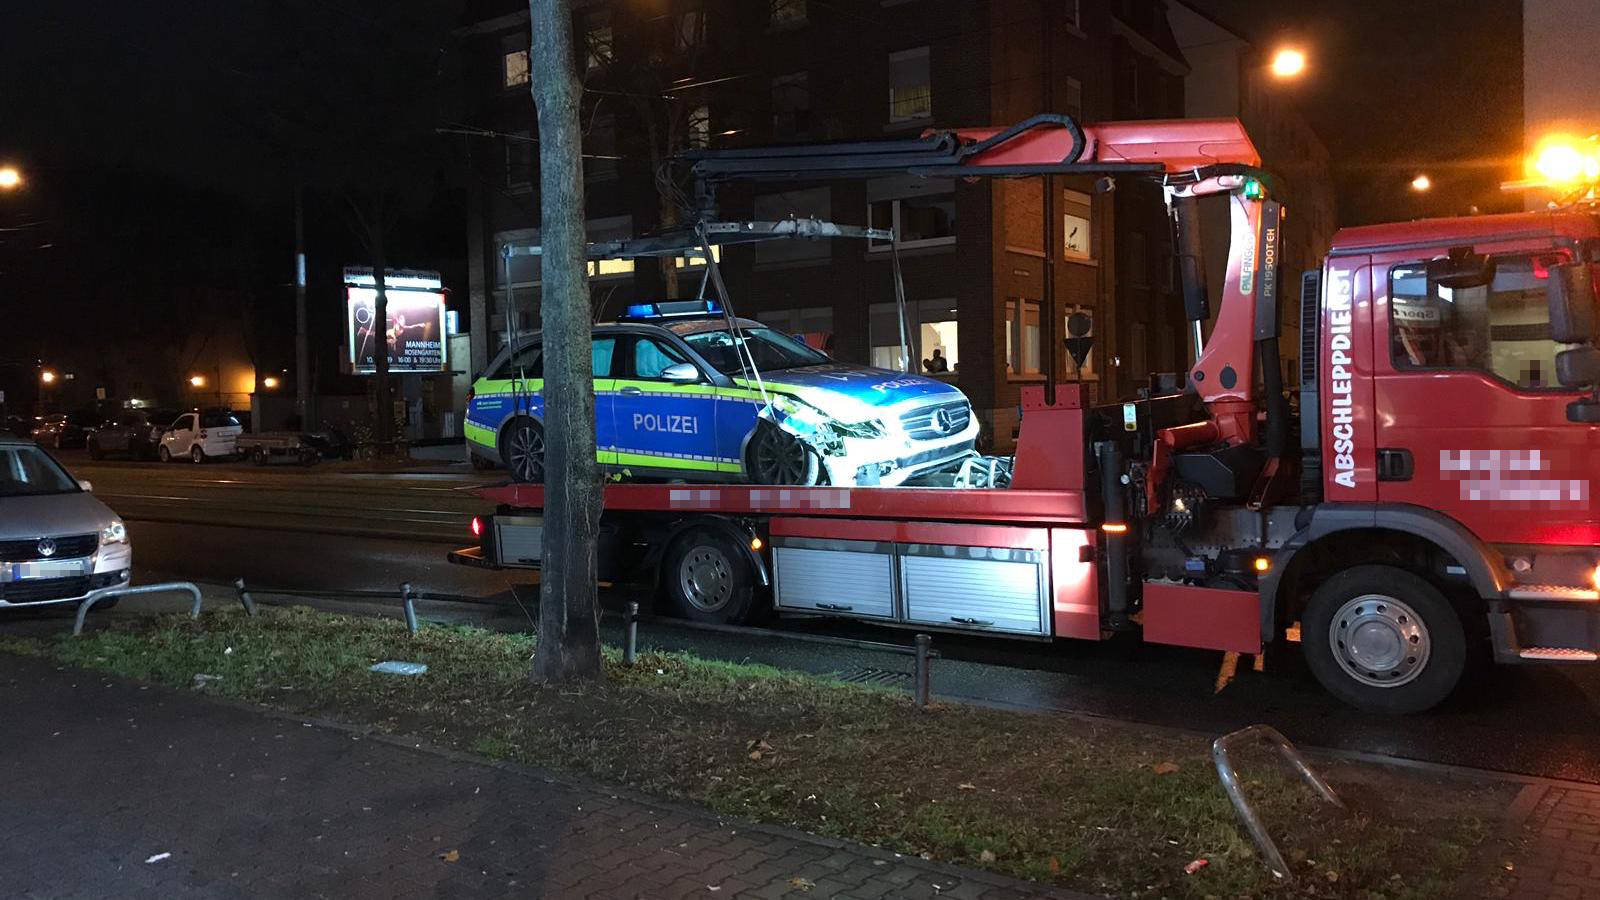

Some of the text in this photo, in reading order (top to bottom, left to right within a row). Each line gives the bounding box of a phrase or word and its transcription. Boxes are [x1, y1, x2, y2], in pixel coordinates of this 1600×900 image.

[1264, 283, 1273, 297] PK
[406, 340, 440, 349] MANNHEIM
[1330, 268, 1355, 488] ABSCHLEPPDIENST
[633, 413, 698, 434] POLIZEI
